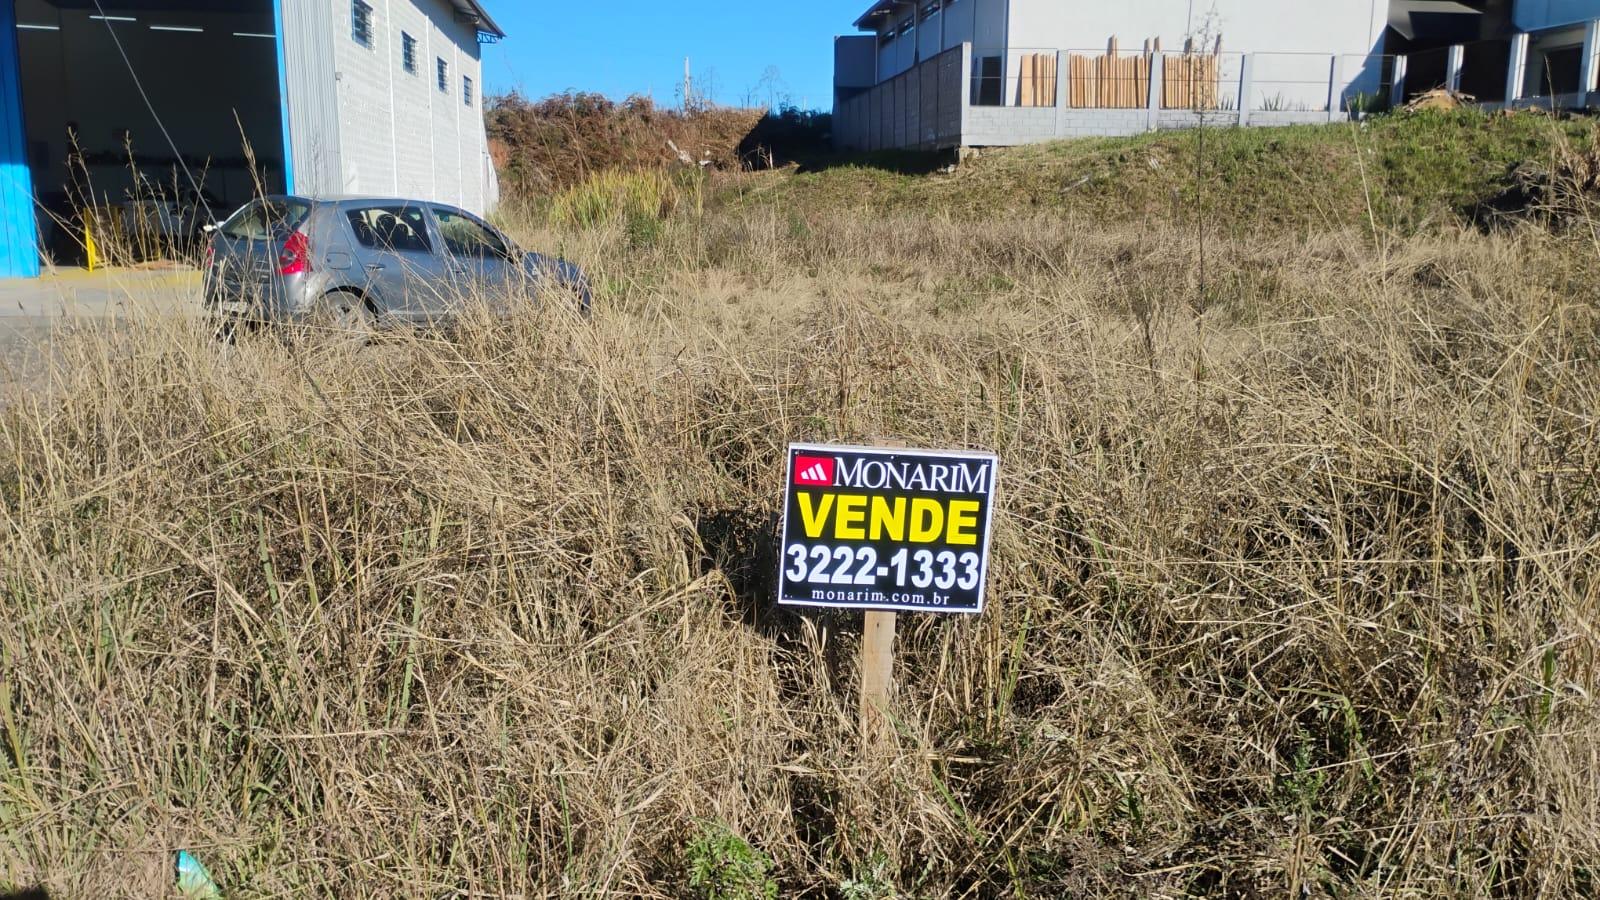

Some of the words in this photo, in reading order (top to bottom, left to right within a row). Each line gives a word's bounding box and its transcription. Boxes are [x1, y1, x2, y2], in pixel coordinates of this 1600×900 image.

[833, 457, 990, 494] MONARIM
[797, 492, 980, 545] VENDE
[785, 543, 980, 591] 3222-1333
[812, 588, 950, 605] monarim.com.br
